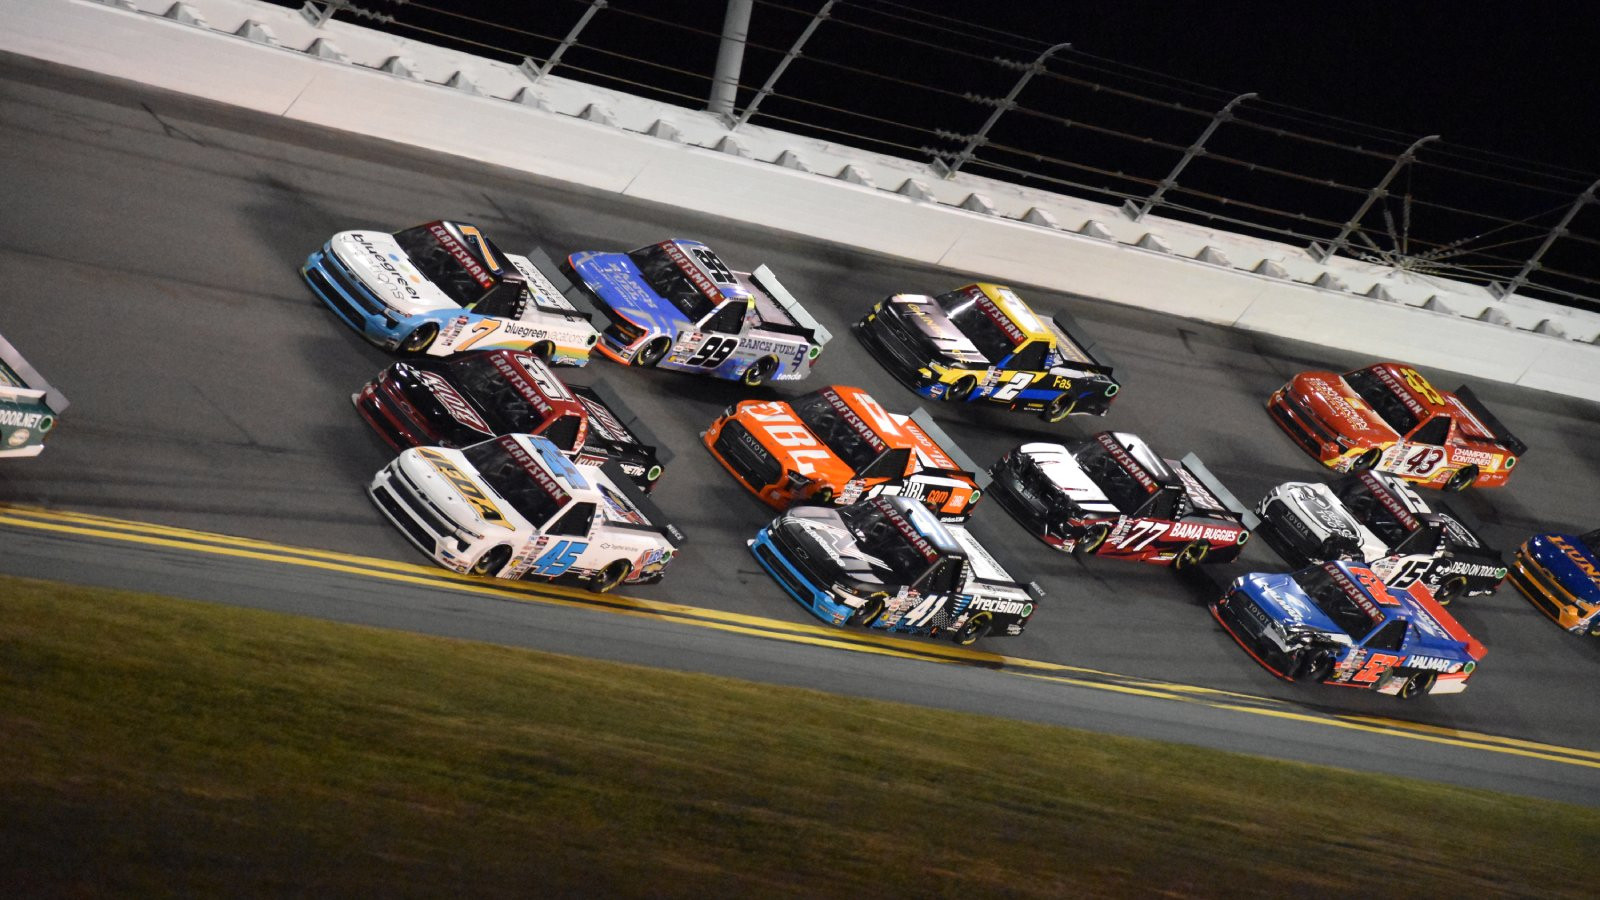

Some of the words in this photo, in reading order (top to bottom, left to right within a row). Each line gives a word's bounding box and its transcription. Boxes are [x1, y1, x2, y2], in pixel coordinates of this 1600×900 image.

[429, 223, 488, 285] CRAFTSMAN
[457, 223, 501, 274] 7
[662, 242, 718, 298] CRAFTSMAN
[691, 248, 738, 285] 99
[968, 287, 1020, 340] CRAFTSMAN
[456, 318, 501, 352] 7
[504, 322, 547, 340] bluegreen
[739, 338, 771, 351] RANCH
[774, 343, 797, 355] FUEL
[685, 334, 740, 369] 99
[490, 354, 548, 413] CRAFTSMAN
[992, 371, 1034, 402] 2
[1372, 366, 1422, 415] CRAFTSMAN
[823, 390, 880, 447] CRAFTSMAN
[742, 402, 831, 475] JBL
[742, 432, 767, 459] TOYOTA
[1454, 448, 1493, 459] CHAMPION
[500, 439, 564, 501] CRAFTSMAN
[1098, 434, 1151, 487] CRAFTSMAN
[1405, 446, 1444, 477] 43
[1452, 454, 1491, 466] CONTAINER
[1360, 474, 1413, 529] CRAFTSMAN
[1384, 476, 1431, 514] 15
[877, 499, 937, 562] CRAFTSMAN
[1117, 520, 1169, 552] 77
[1169, 522, 1203, 539] BAMA
[1203, 528, 1238, 542] BUGGIES
[1285, 511, 1309, 534] TOYOTA
[532, 540, 588, 577] 45
[1385, 559, 1433, 589] 15
[1451, 562, 1469, 575] DEAD
[1468, 564, 1480, 576] ON
[968, 594, 1024, 614] Precision
[1325, 563, 1377, 621] CRAFTSMAN
[904, 595, 948, 627] 41
[1249, 603, 1270, 624] TOYOT
[1352, 653, 1400, 683] 52
[1408, 655, 1450, 673] HALMAR
